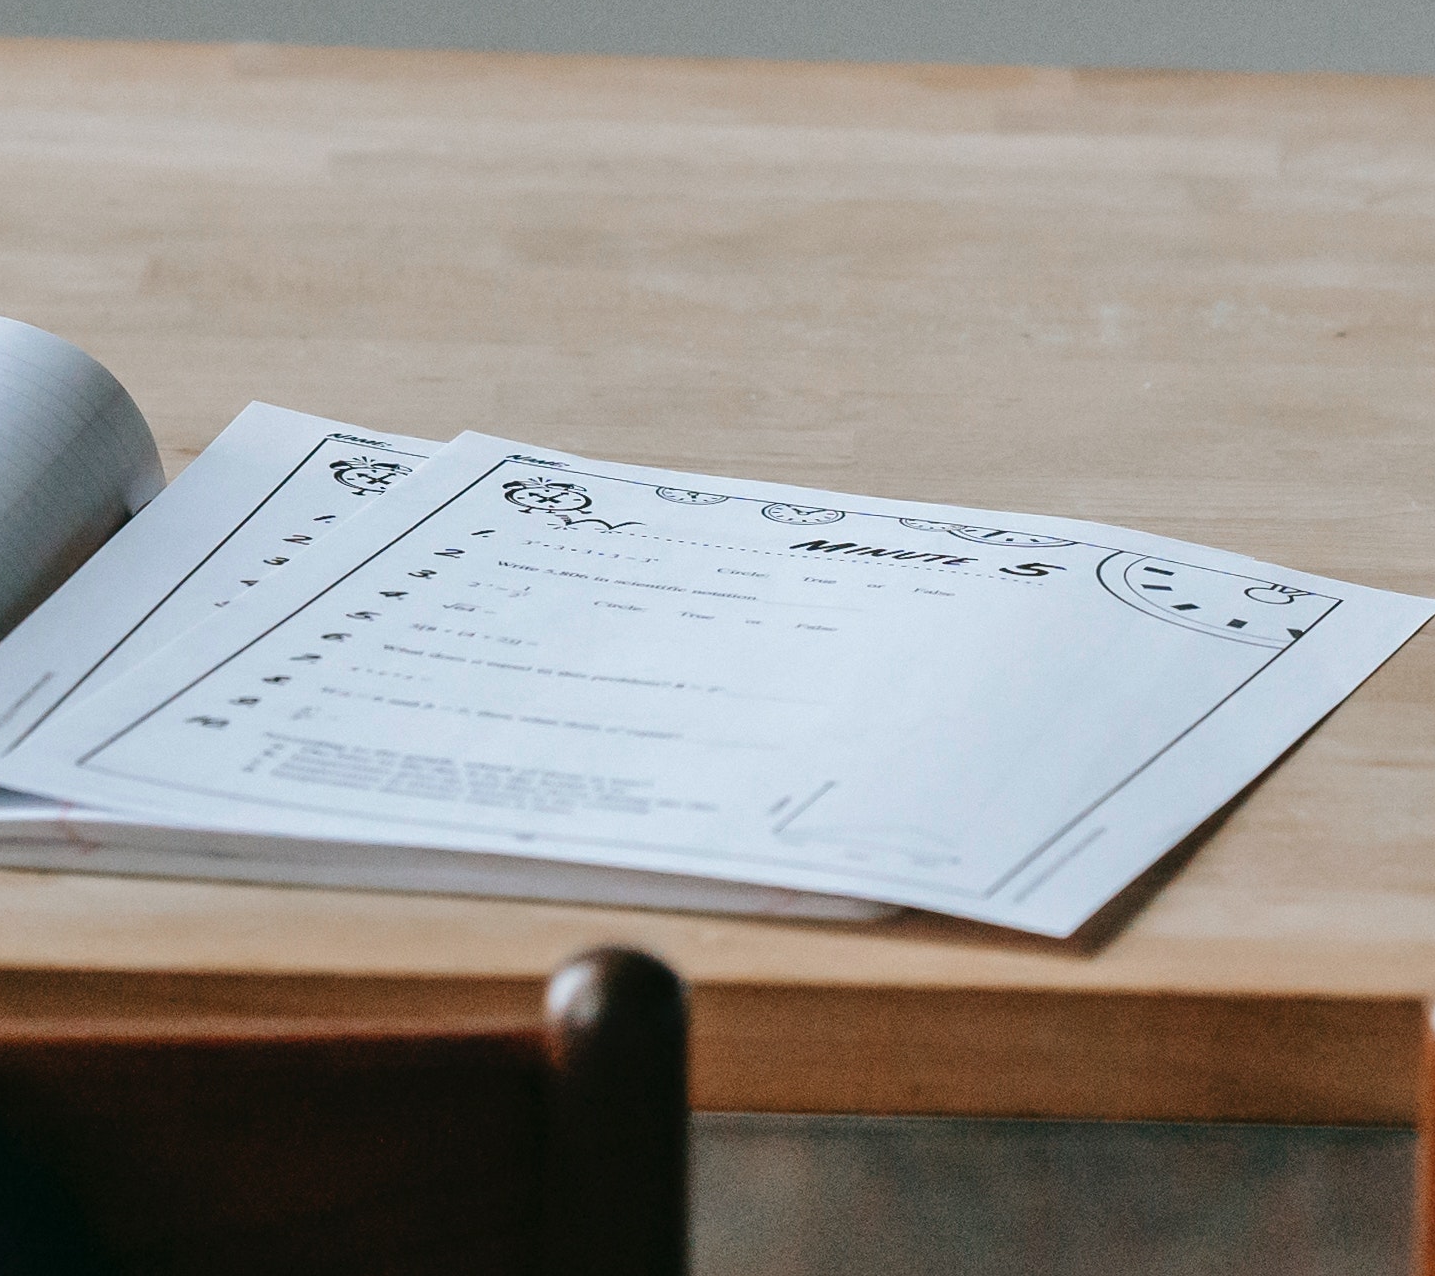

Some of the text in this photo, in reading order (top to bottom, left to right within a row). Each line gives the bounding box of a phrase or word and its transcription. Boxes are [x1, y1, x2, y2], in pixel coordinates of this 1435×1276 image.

[789, 539, 1067, 578] MINUTE 5
[498, 560, 540, 572] Write
[613, 579, 687, 593] scientific
[803, 575, 838, 586] True
[913, 586, 957, 598] False
